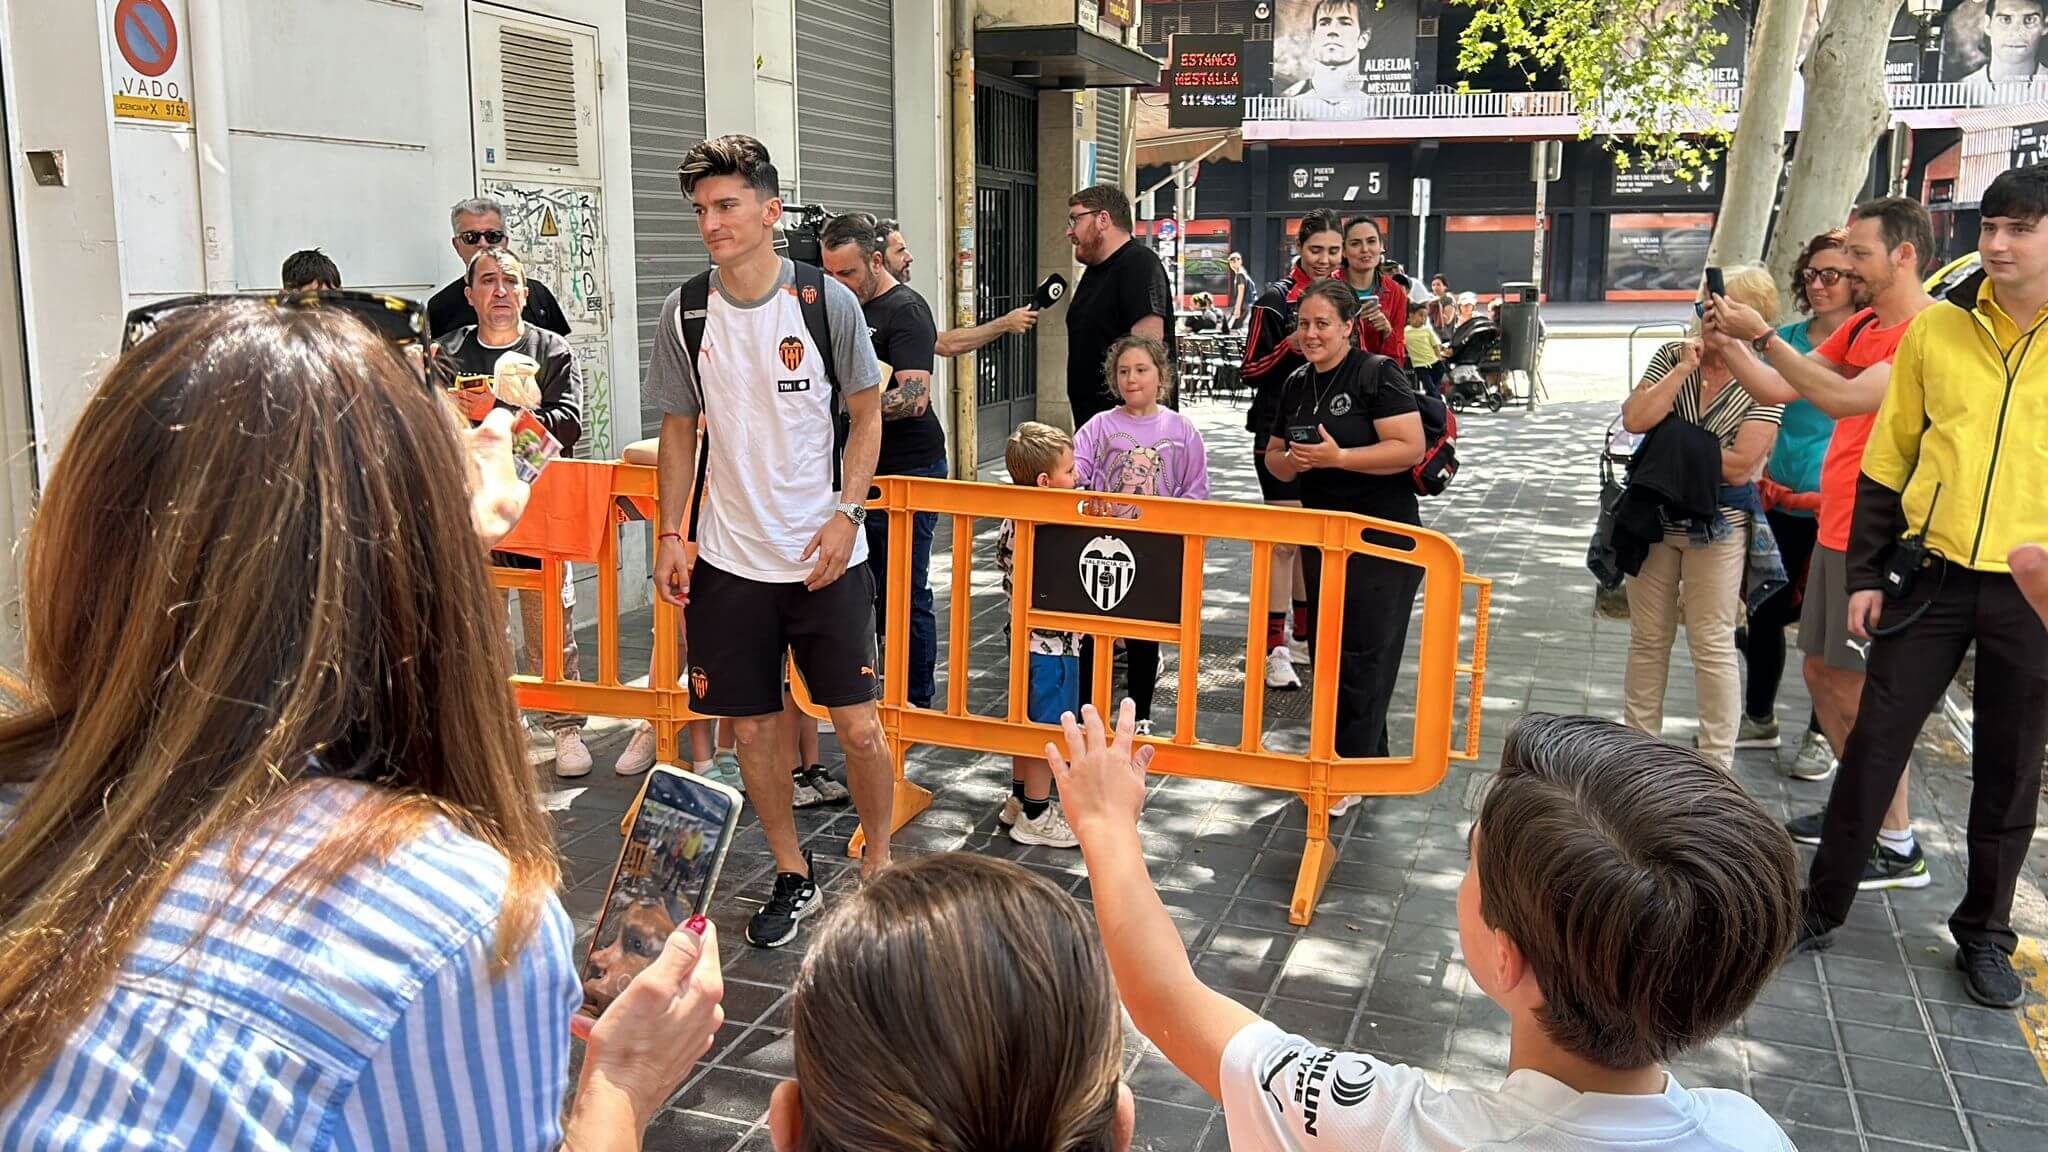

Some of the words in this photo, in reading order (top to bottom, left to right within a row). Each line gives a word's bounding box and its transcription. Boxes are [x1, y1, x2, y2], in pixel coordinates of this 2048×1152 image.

[1181, 53, 1237, 67] ESTANCO
[1364, 58, 1411, 72] ALBELDA
[1886, 60, 1914, 74] MUNT
[122, 77, 179, 99] VADO
[1367, 82, 1411, 93] MESTALLA
[150, 104, 157, 115] X
[166, 104, 186, 117] 9762
[1368, 172, 1381, 194] 5
[1085, 559, 1117, 567] VALENCIA
[1294, 1055, 1317, 1103] TYRE
[1304, 1050, 1337, 1137] AILUN
